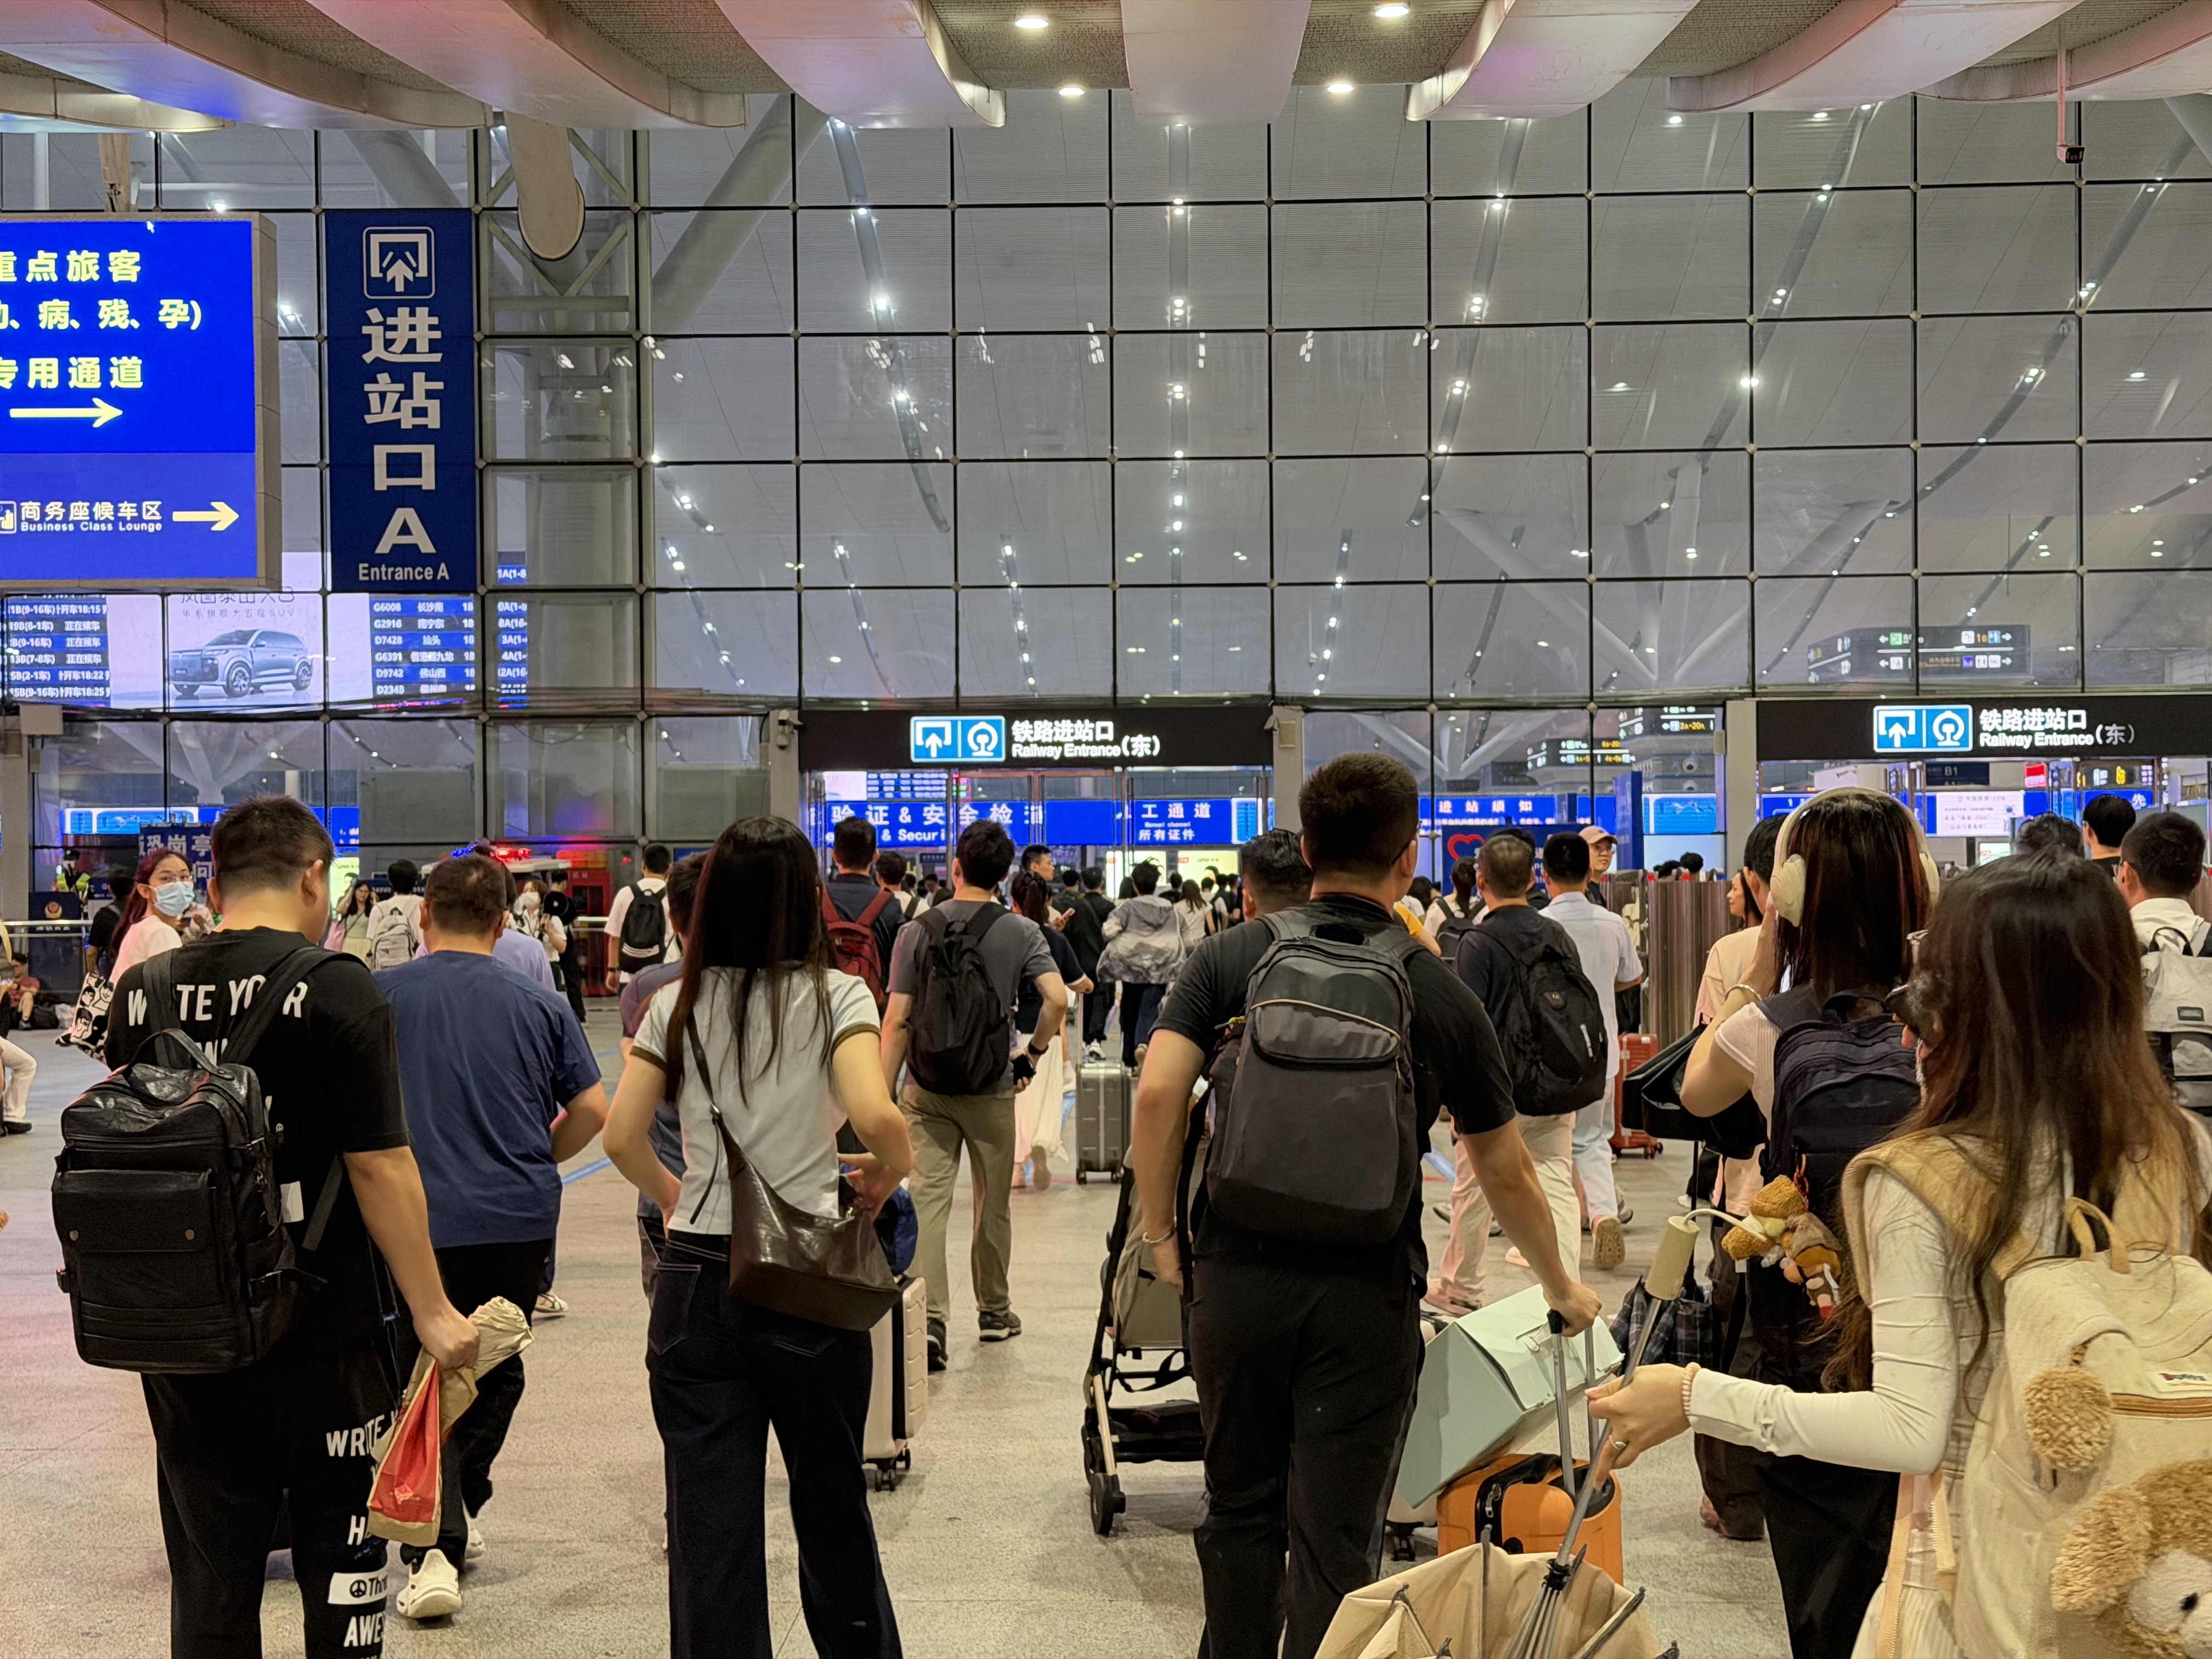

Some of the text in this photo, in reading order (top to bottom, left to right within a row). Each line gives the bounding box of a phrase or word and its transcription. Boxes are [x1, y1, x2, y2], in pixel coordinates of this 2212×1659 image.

[0, 356, 143, 388] 专用通道
[20, 501, 162, 521] 商务座候车区
[21, 521, 162, 533] Business Class Lounge
[358, 563, 450, 581] Entrance A
[1979, 708, 2135, 745] 铁路进站口 (东)
[1012, 719, 1160, 758] 铁路进站口 (东)
[1979, 732, 2094, 749] Railway Entrance
[1012, 743, 1121, 760] Railway Entrance
[1138, 829, 1195, 841] 所有证件
